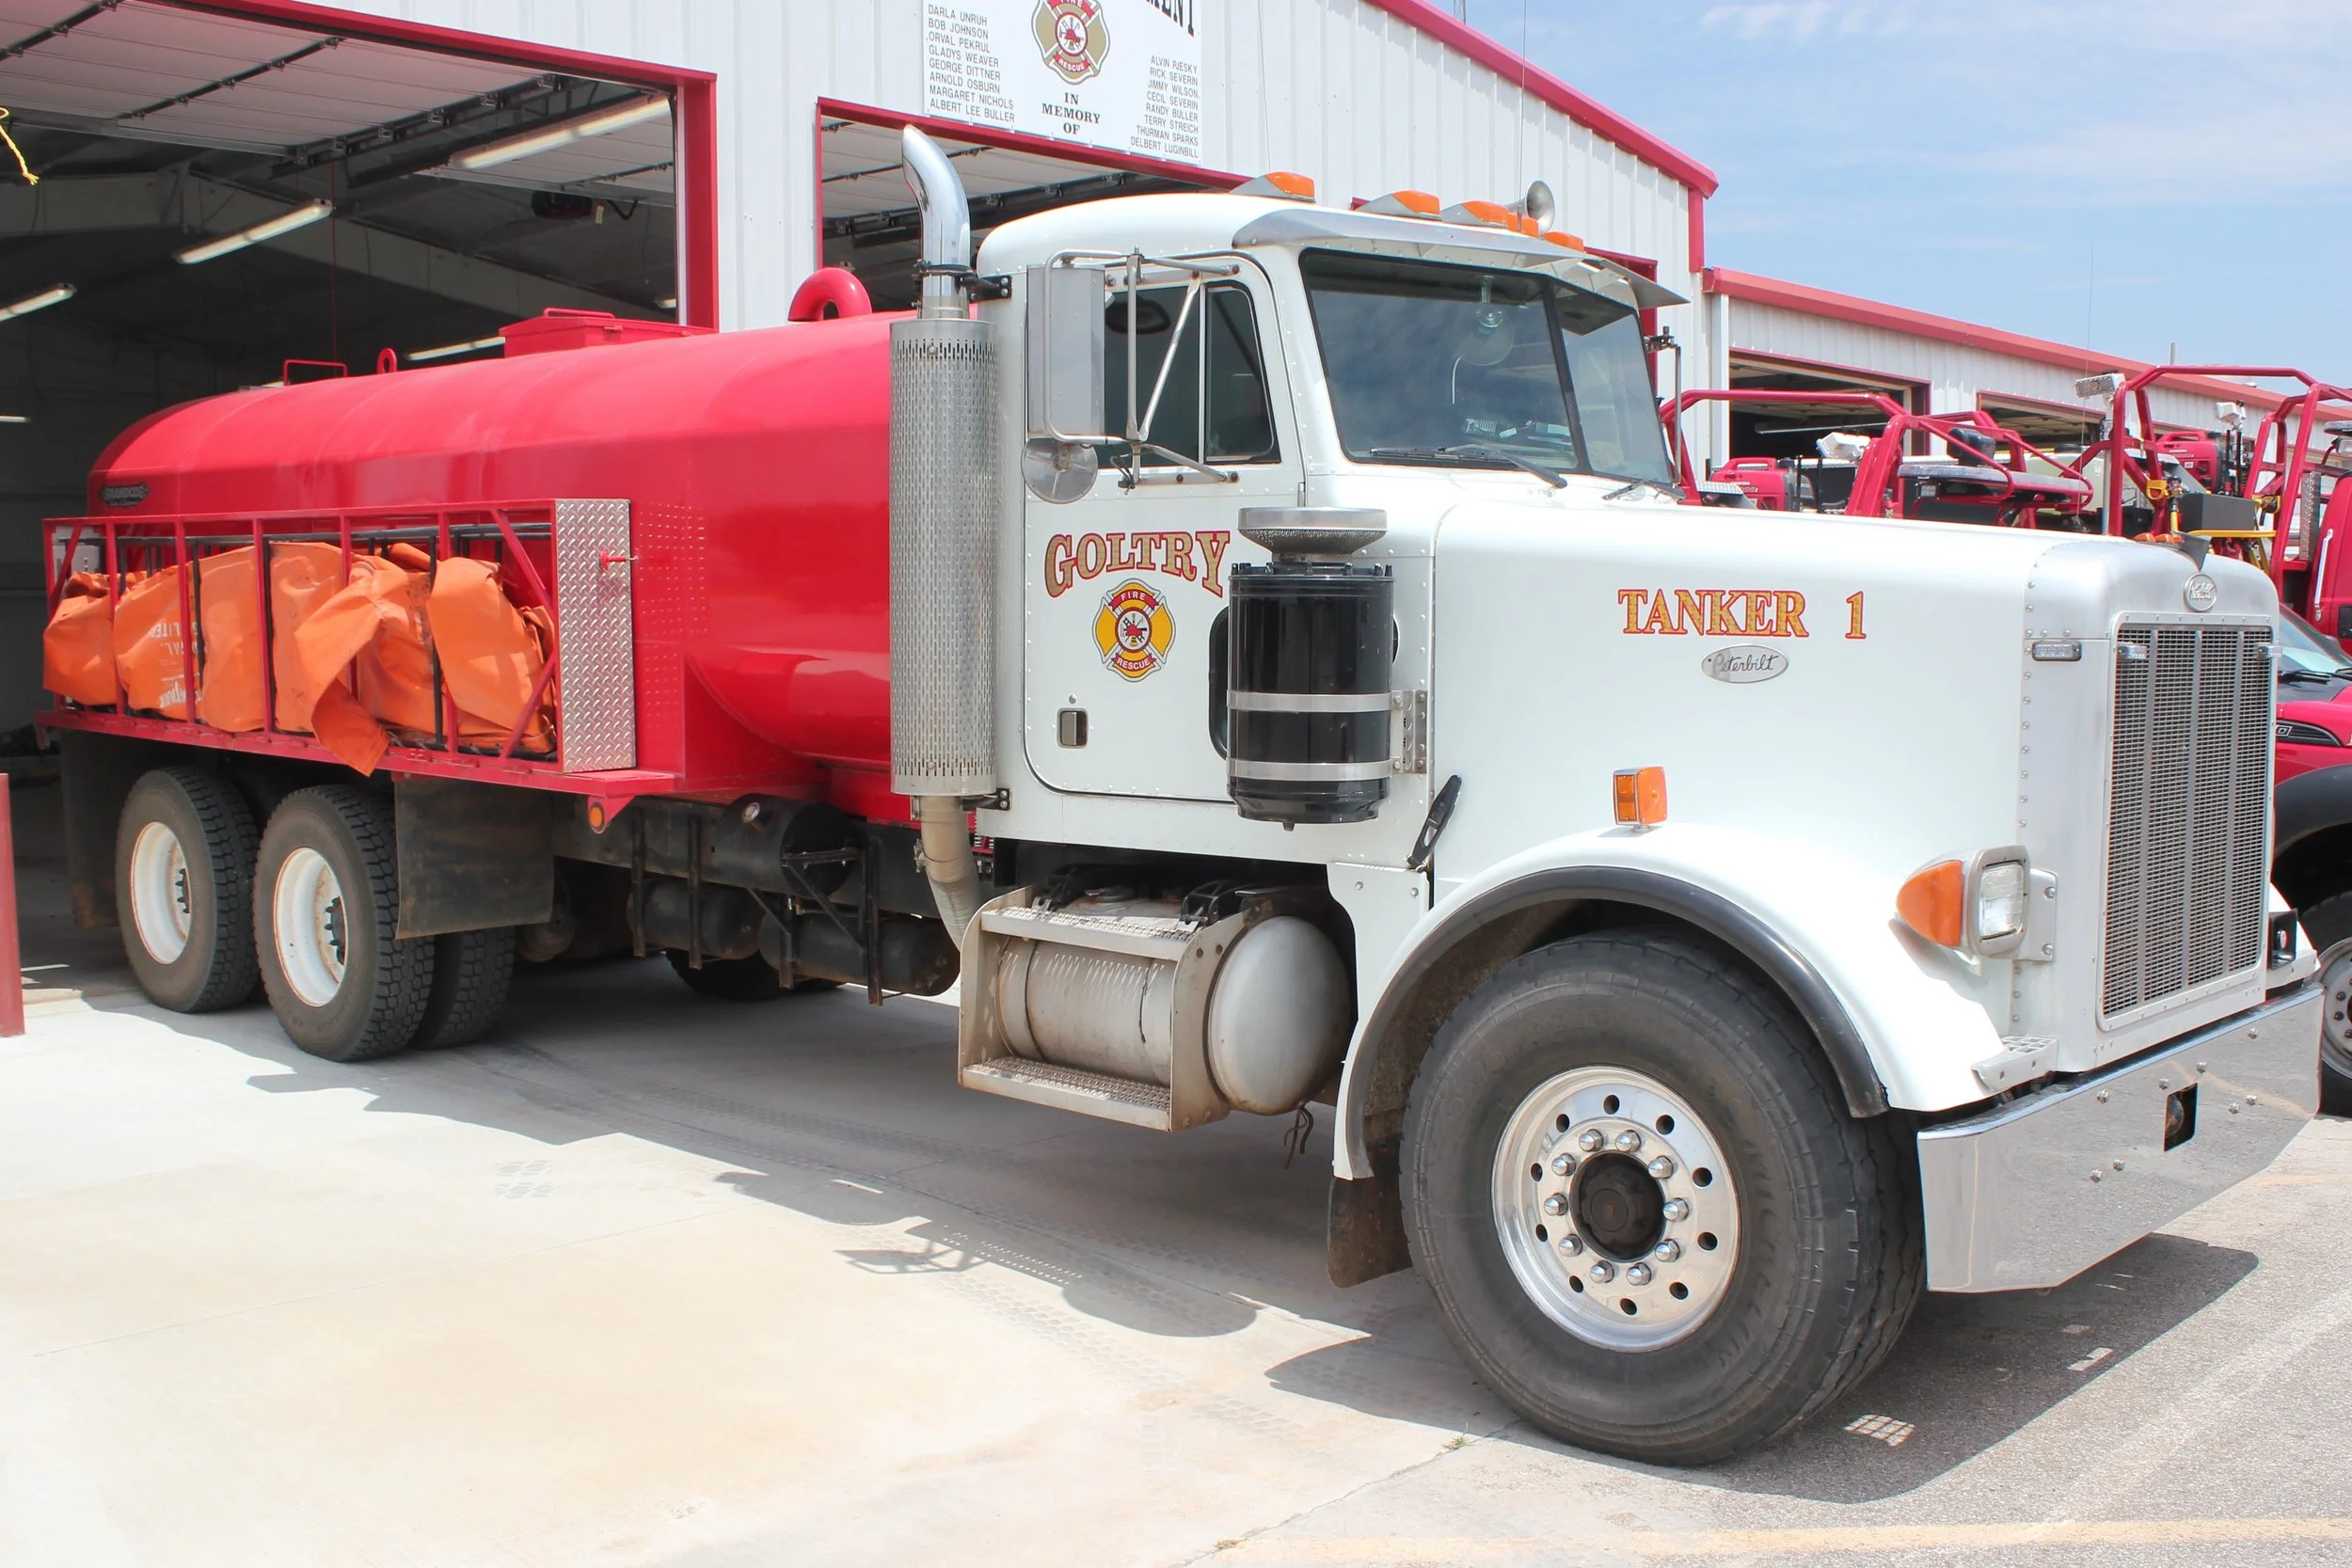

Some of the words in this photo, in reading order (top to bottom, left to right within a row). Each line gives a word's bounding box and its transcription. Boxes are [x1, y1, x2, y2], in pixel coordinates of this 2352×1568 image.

[929, 5, 956, 19] DARLA
[960, 11, 987, 26] UNRUH
[929, 18, 946, 30] BOB
[950, 23, 988, 40] JOHNSON
[929, 31, 955, 45] ORVAL
[960, 38, 990, 53] PEKRUL
[930, 45, 961, 60] GLADYS
[965, 52, 999, 68] WEAVER
[1058, 57, 1085, 71] RESCUE
[1152, 55, 1169, 68] ALVIN
[1172, 60, 1197, 74] PJESKY
[930, 58, 962, 73] GEORGE
[967, 65, 1000, 81] DITTNER
[1151, 67, 1167, 79] RICK
[1169, 71, 1198, 87] SEVERIN
[930, 71, 962, 87] ARNOLD
[967, 79, 1000, 94] OSBURN
[1148, 79, 1168, 91] JIMMY
[1172, 83, 1198, 98] WILSON
[930, 85, 976, 102] MARGARET
[979, 94, 1013, 109] NICHOLS
[1065, 92, 1078, 105] IN
[1147, 91, 1167, 103] CECIL
[1169, 96, 1198, 111] SEVERIN
[930, 99, 961, 113] ALBERT
[966, 105, 980, 117] LEE
[984, 108, 1014, 122] BULLER
[1041, 103, 1101, 124] MEMORY
[1146, 103, 1168, 116] RANDY
[1172, 108, 1198, 122] BULLER
[1063, 122, 1080, 135] OF
[1145, 115, 1167, 128] TERRY
[1170, 120, 1198, 134] STREICH
[1136, 125, 1168, 140] THURMAN
[1172, 133, 1198, 146] SPARKS
[1131, 136, 1161, 150] DELBERT
[1165, 143, 1199, 158] LUGINBILL
[1044, 531, 1231, 598] GOLTRY
[1120, 591, 1147, 601] FIRE
[1618, 589, 1809, 638] TANKER
[1845, 591, 1867, 640] 1
[1117, 657, 1151, 670] RESCUE
[1712, 654, 1779, 673] Peterbilt
